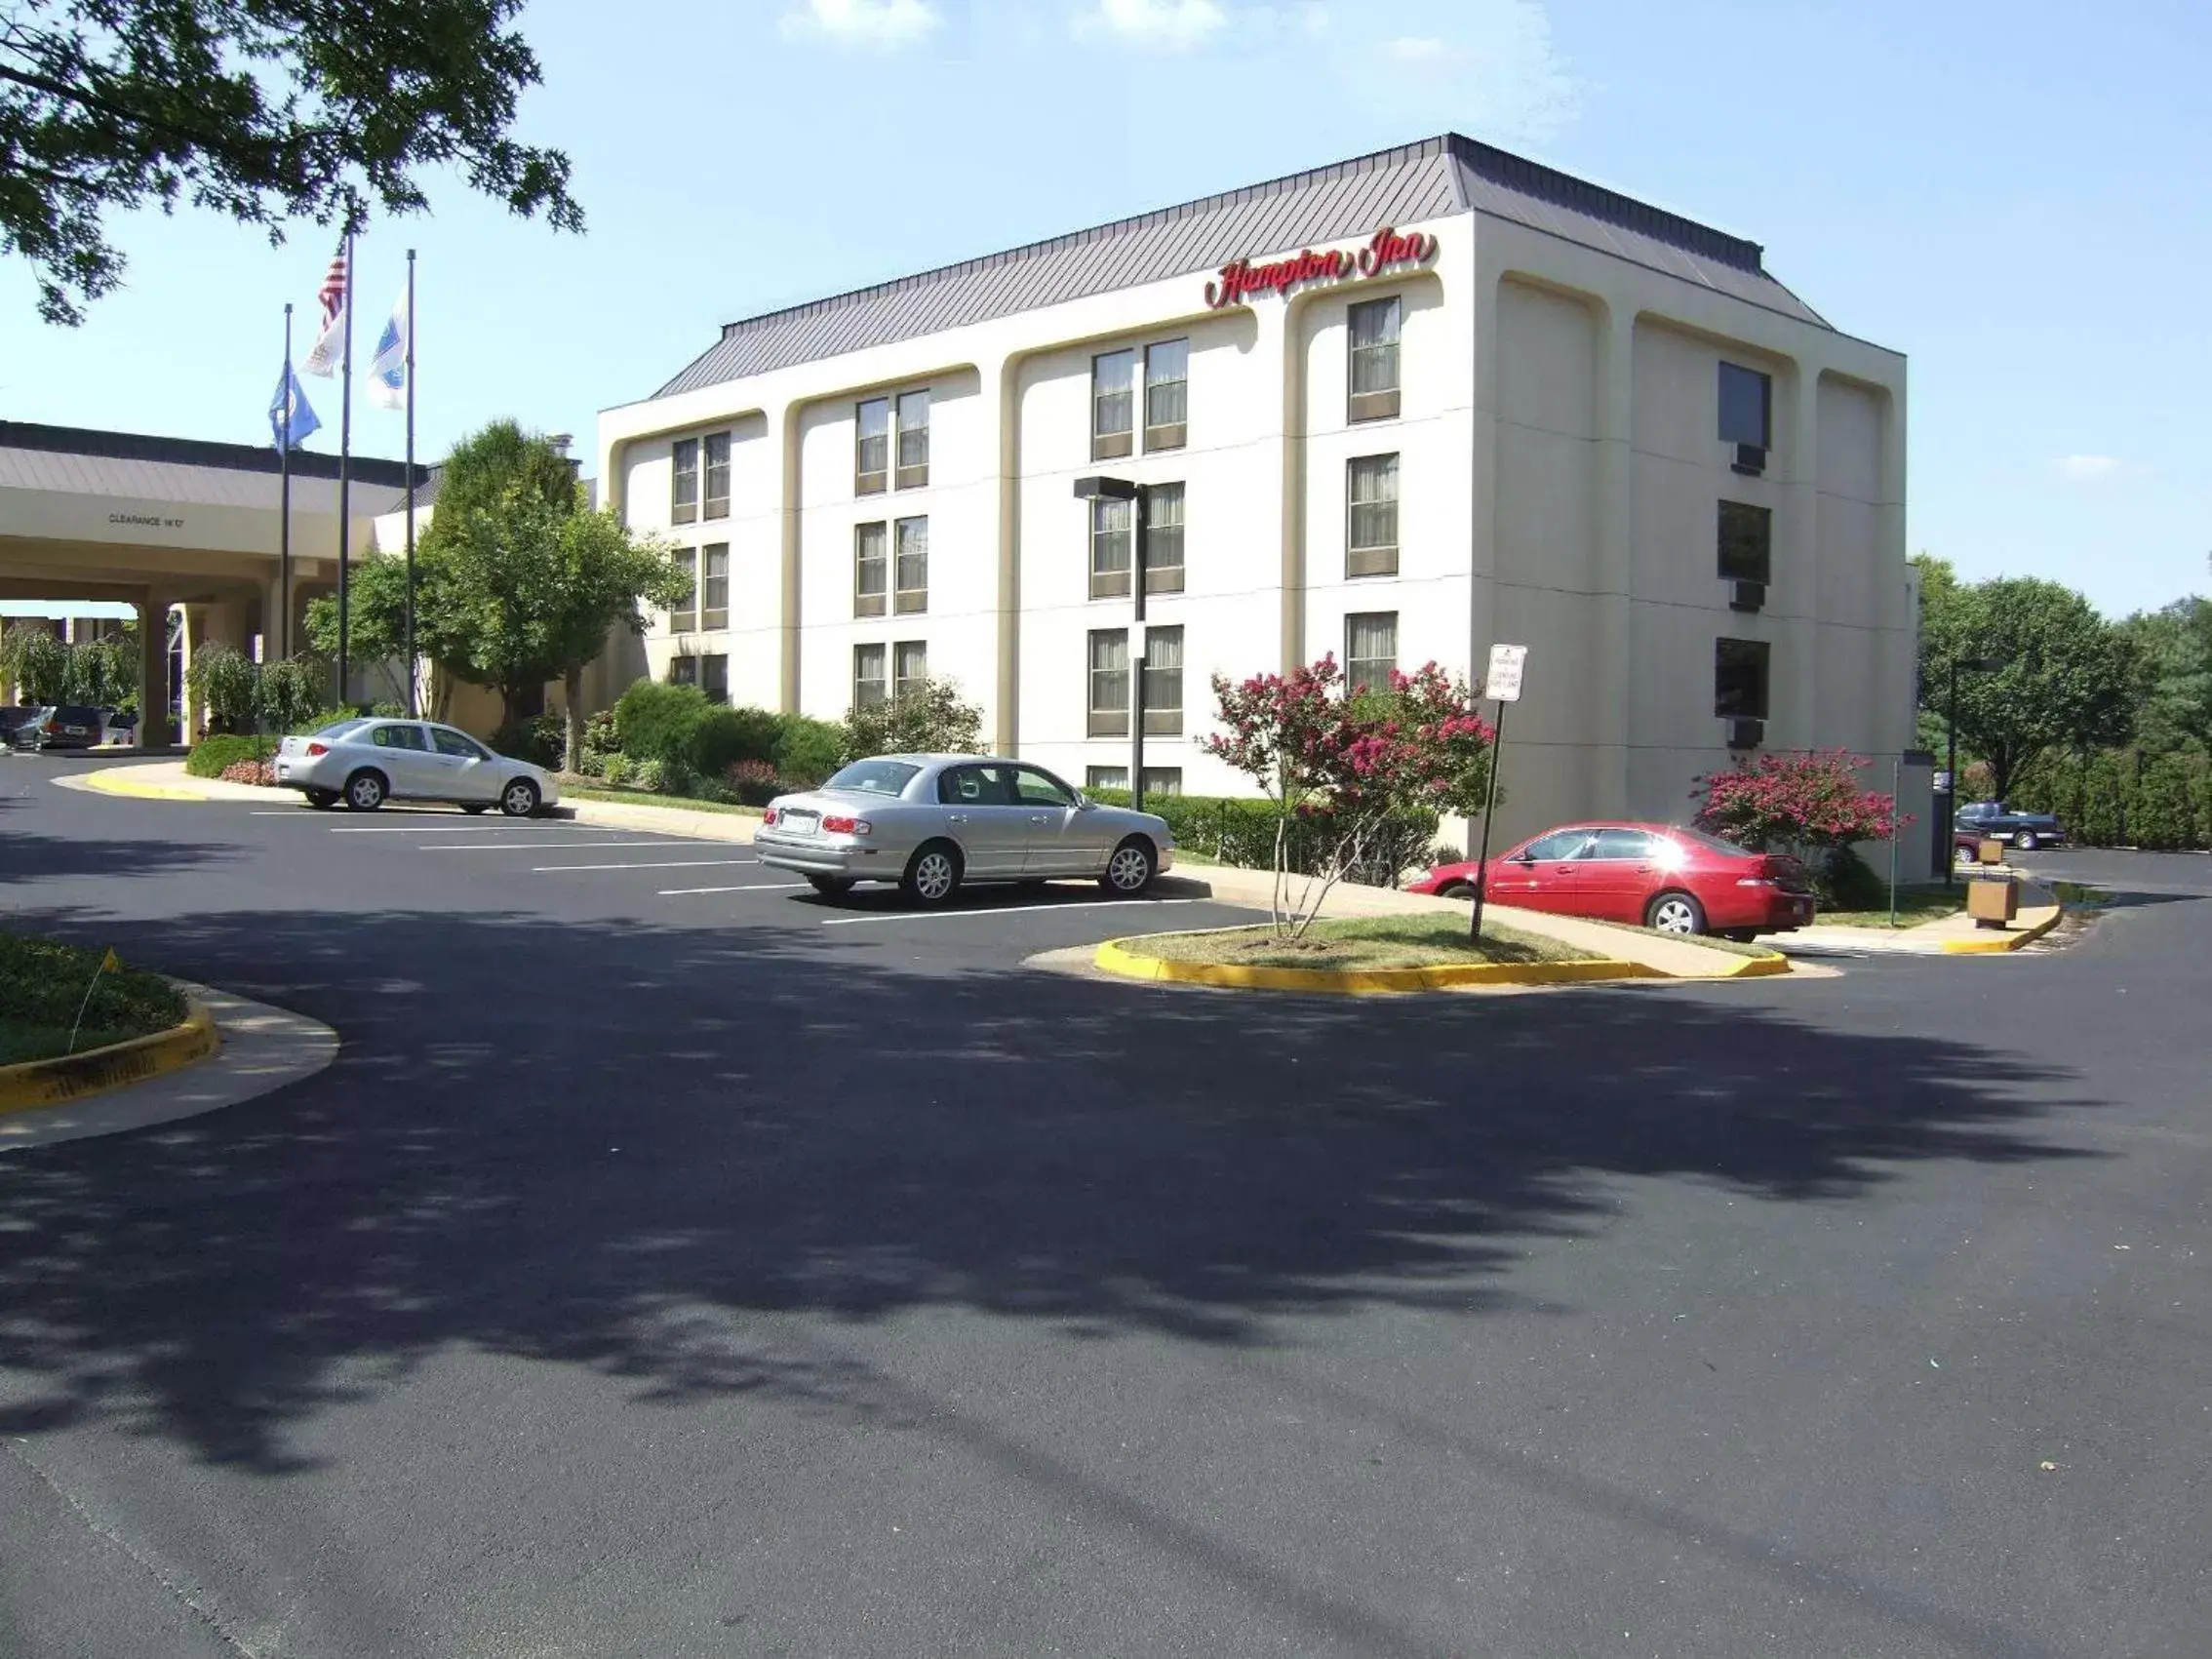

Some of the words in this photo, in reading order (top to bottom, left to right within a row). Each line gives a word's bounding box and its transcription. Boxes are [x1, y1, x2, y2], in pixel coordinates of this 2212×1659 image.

[1205, 250, 1354, 308] Hampton
[1359, 227, 1439, 278] Inn
[108, 513, 161, 526] CLEARANCE
